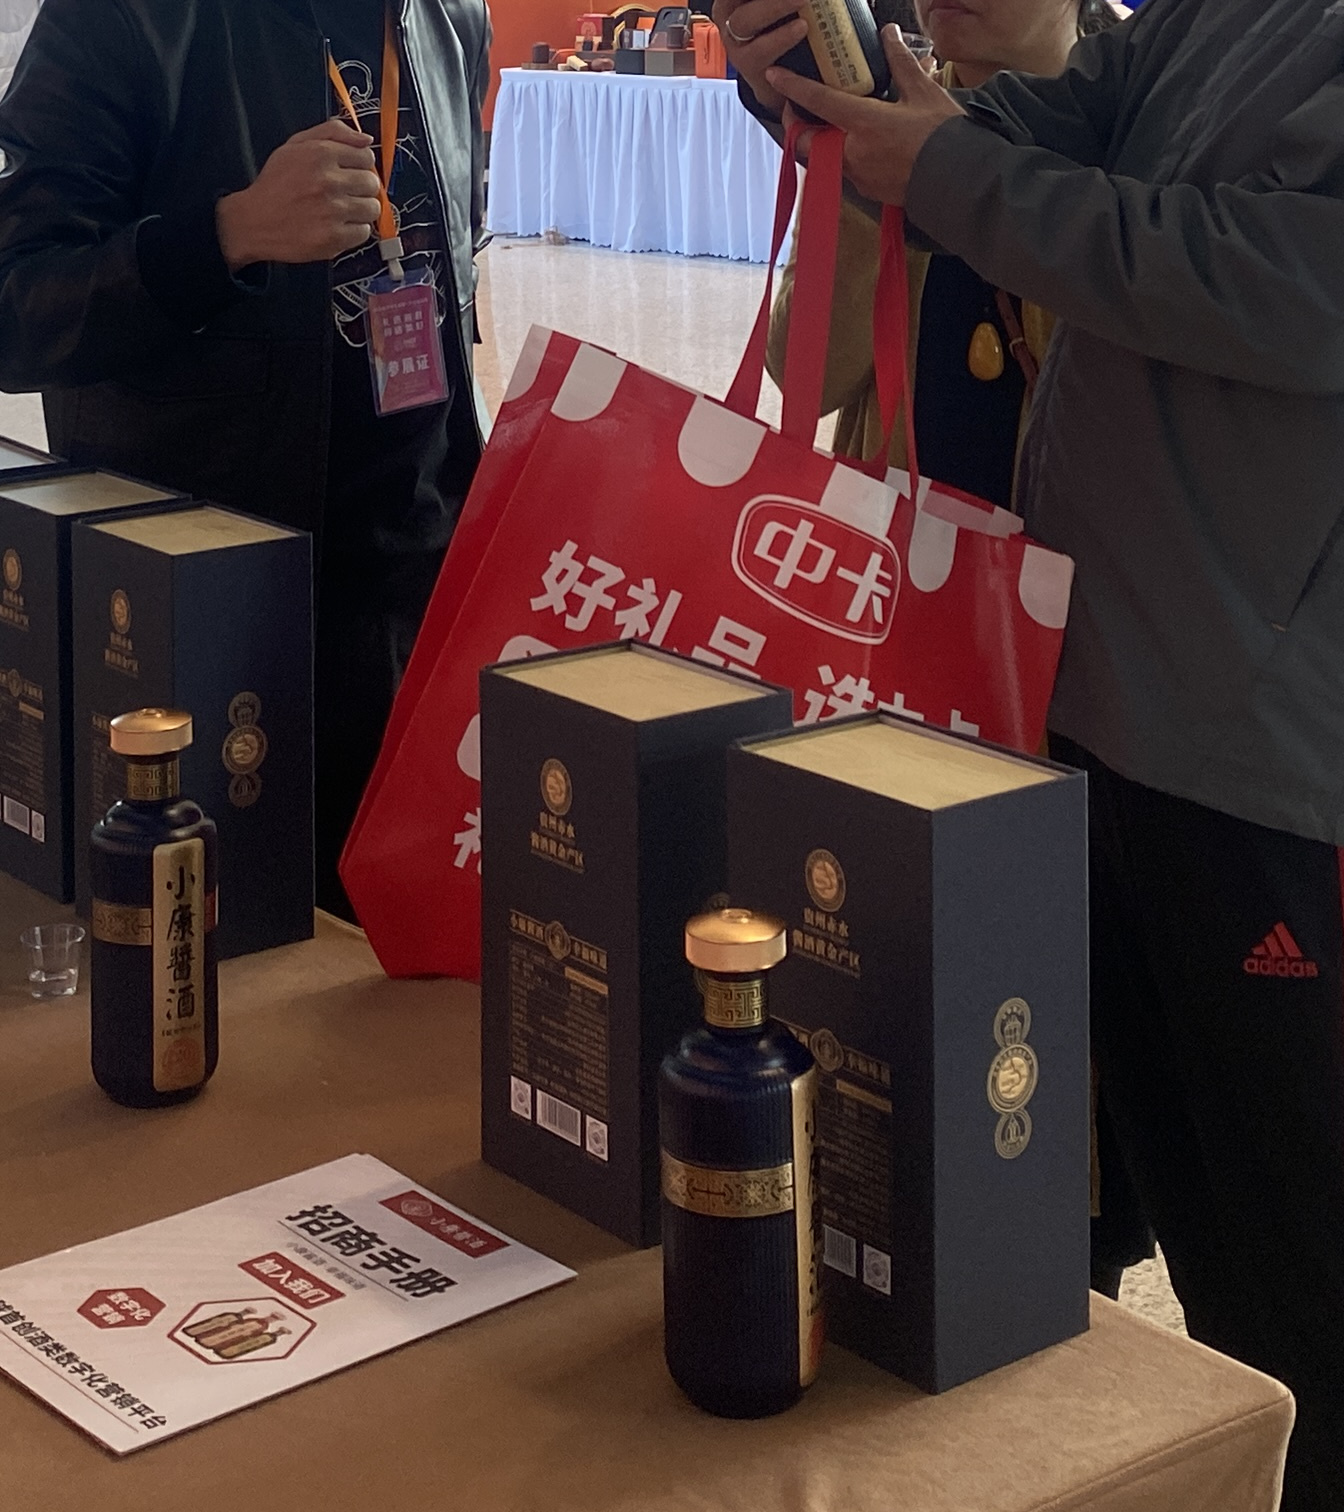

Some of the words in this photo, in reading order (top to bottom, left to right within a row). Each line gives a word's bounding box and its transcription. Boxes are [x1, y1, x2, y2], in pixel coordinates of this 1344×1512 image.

[388, 354, 430, 377] 参展证
[753, 518, 893, 625] 中卡
[530, 539, 767, 678] 好礼品
[1244, 957, 1318, 978] adidas
[253, 1258, 331, 1304] 加入我们
[285, 1204, 458, 1298] 招商手册
